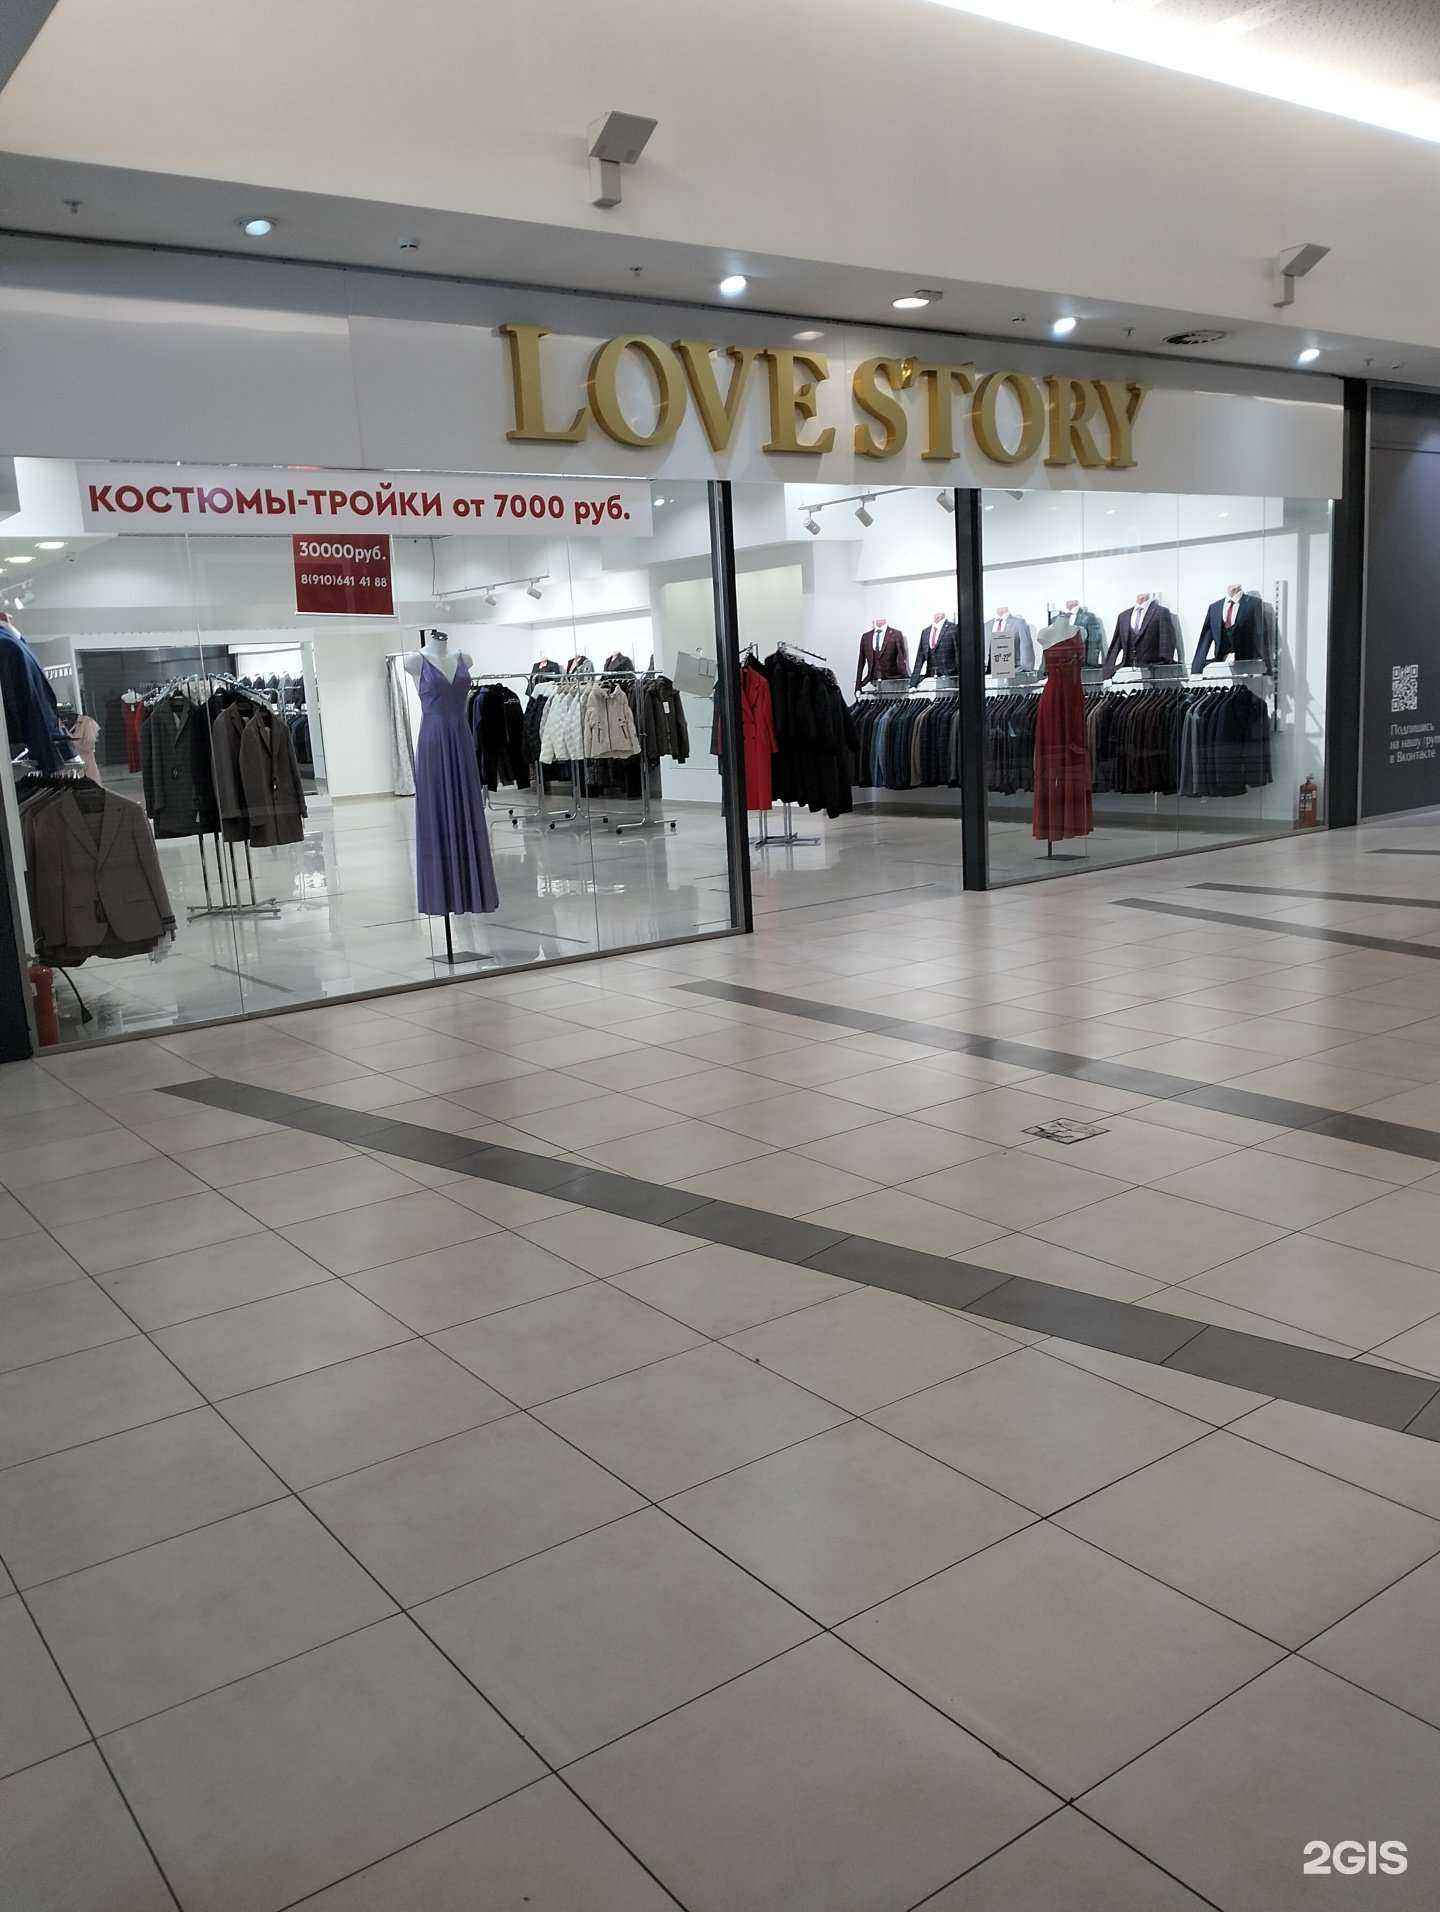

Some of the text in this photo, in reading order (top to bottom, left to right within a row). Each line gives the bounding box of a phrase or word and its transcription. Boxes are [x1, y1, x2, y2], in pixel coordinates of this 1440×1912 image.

[496, 322, 1152, 469] LOVE STORY
[88, 482, 631, 525] КОСТЮМЫ-ТРОЙКИ от 7000 руб.
[299, 541, 387, 563] 30000руб.
[301, 574, 388, 588] 8(910)641 41 88
